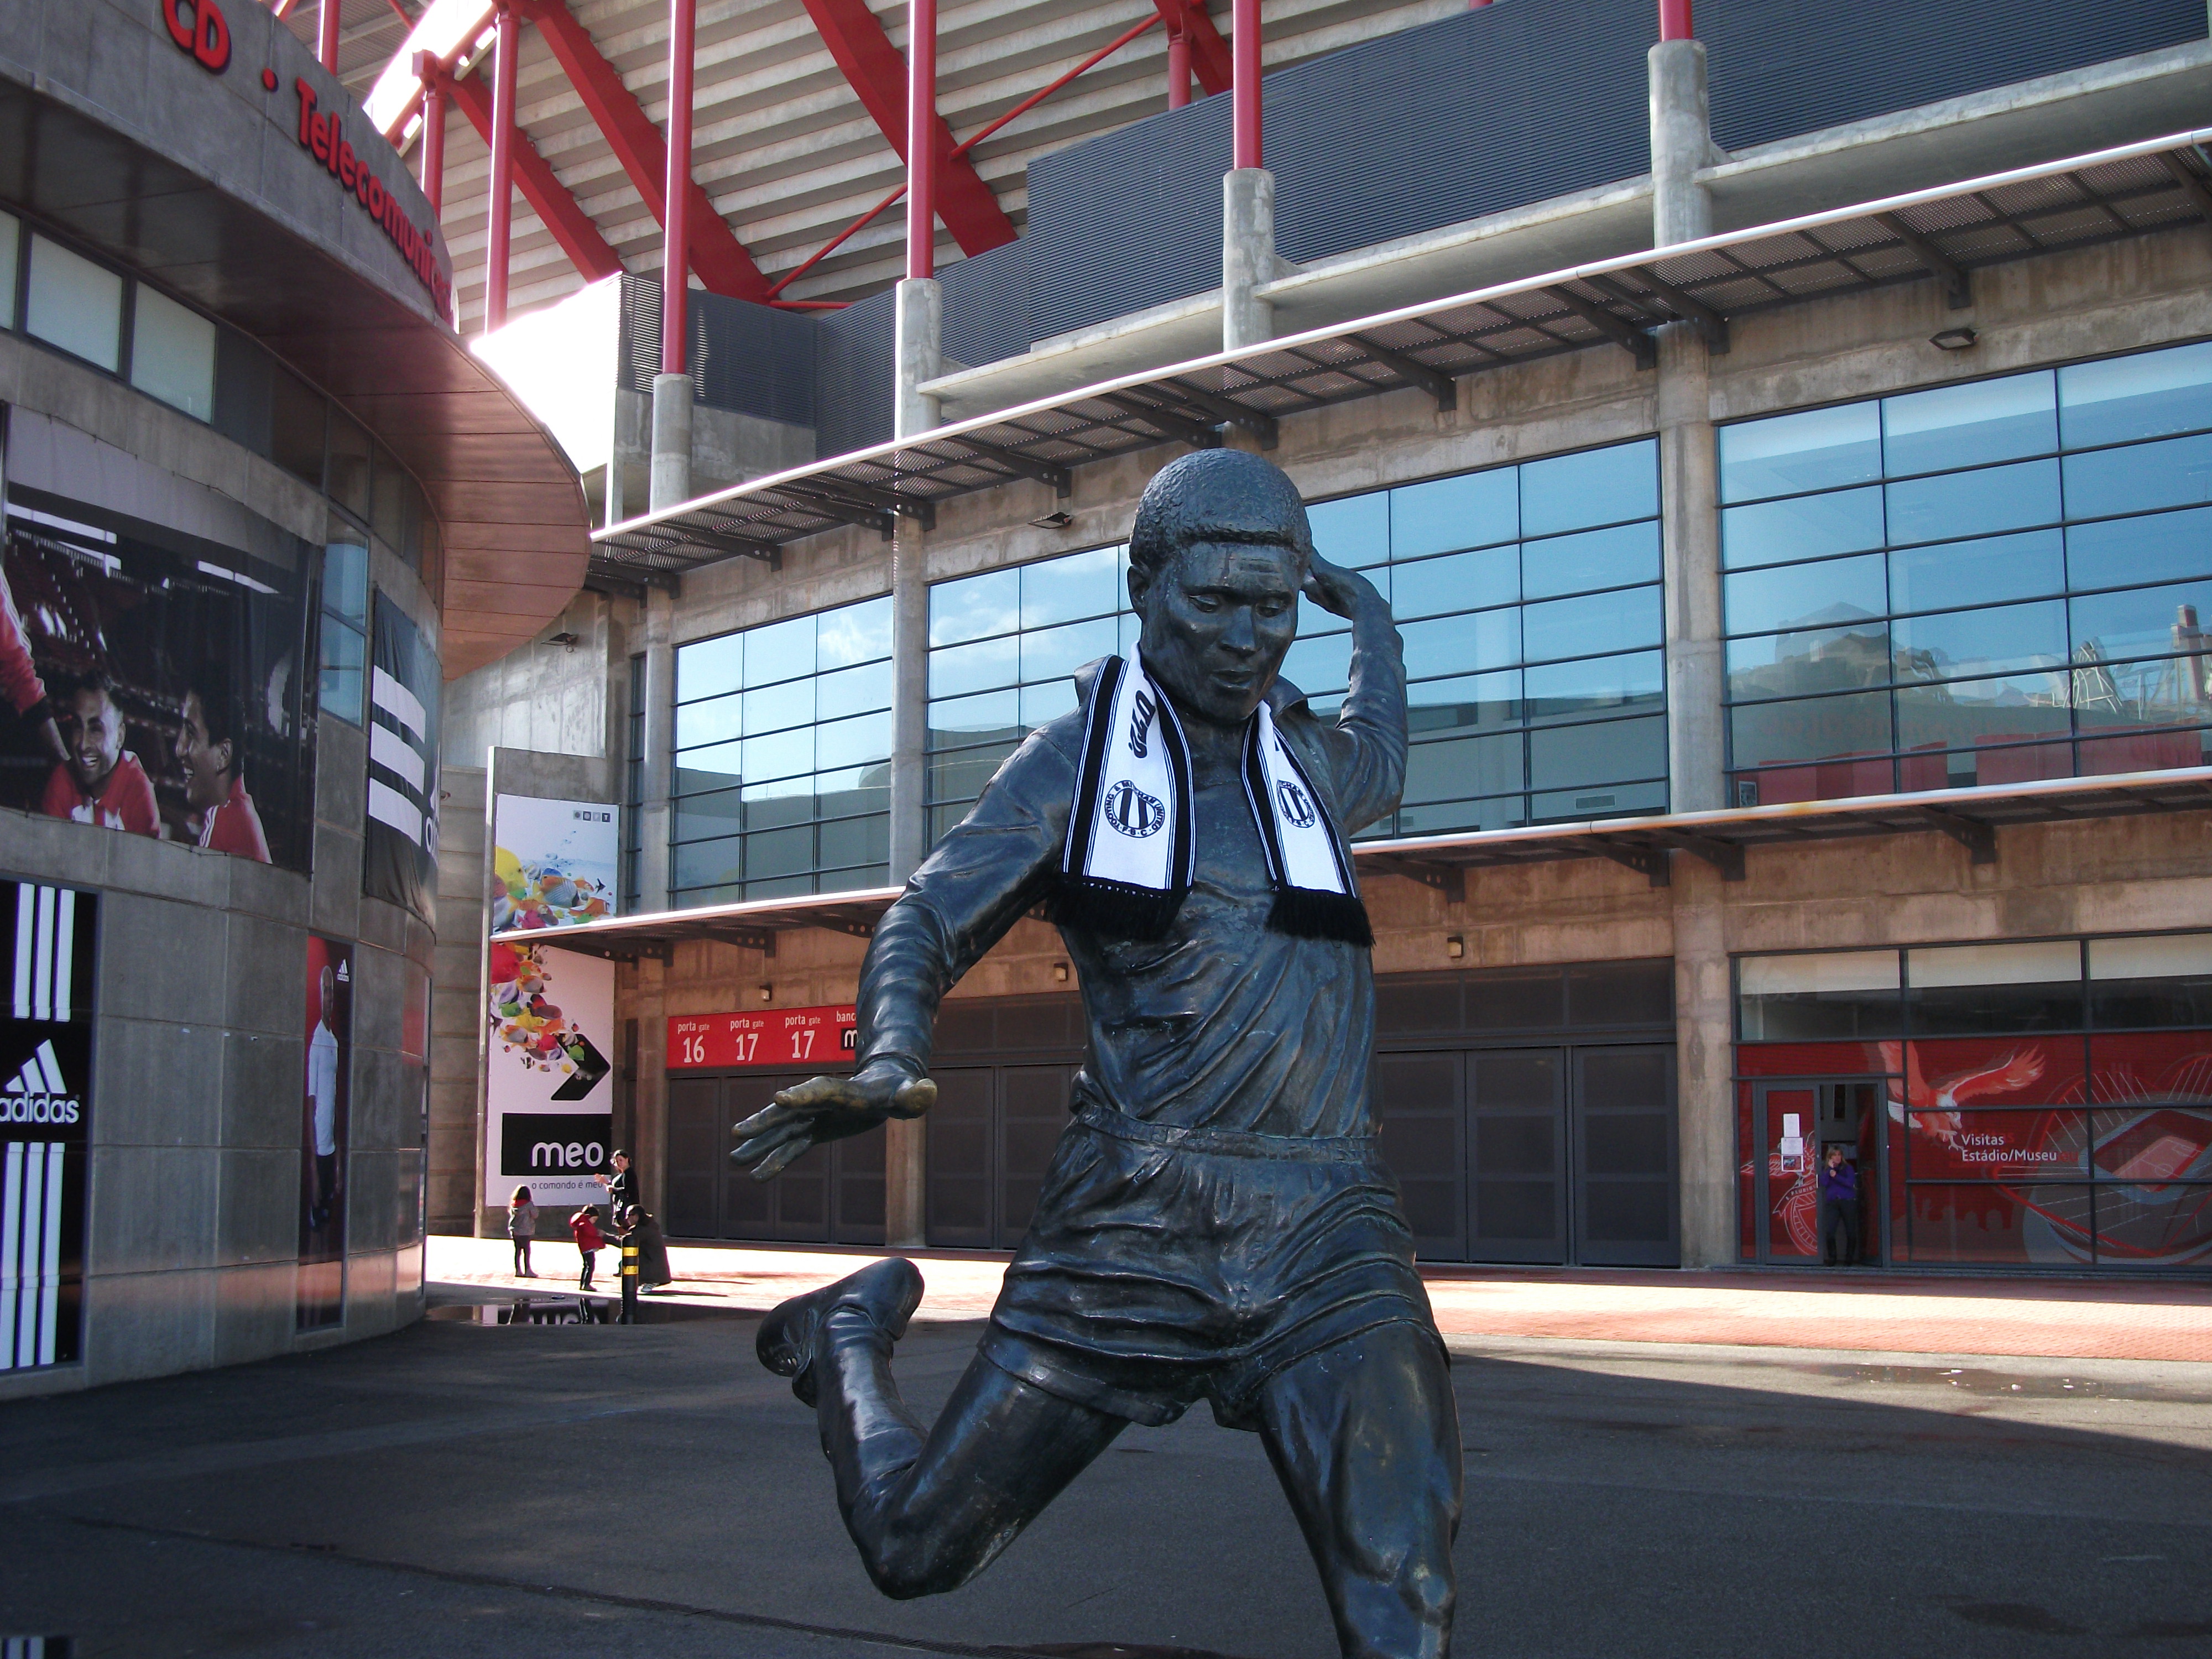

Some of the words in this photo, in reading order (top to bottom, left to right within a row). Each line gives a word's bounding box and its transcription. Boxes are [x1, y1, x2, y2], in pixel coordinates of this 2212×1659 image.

[785, 1015, 806, 1029] porta
[808, 1016, 821, 1026] gate
[836, 1010, 857, 1022] banc
[677, 1021, 696, 1035] porta
[698, 1024, 710, 1032] gate
[730, 1018, 750, 1031] porta
[752, 1020, 764, 1029] gate
[683, 1035, 705, 1063] 16
[736, 1033, 759, 1062] 17
[791, 1030, 815, 1060] 17
[0, 1091, 80, 1123] adidas
[1961, 1134, 2005, 1145] Visitas
[531, 1141, 604, 1167] meo
[1962, 1149, 2057, 1161] Estádio/Museu
[578, 1180, 583, 1188] é
